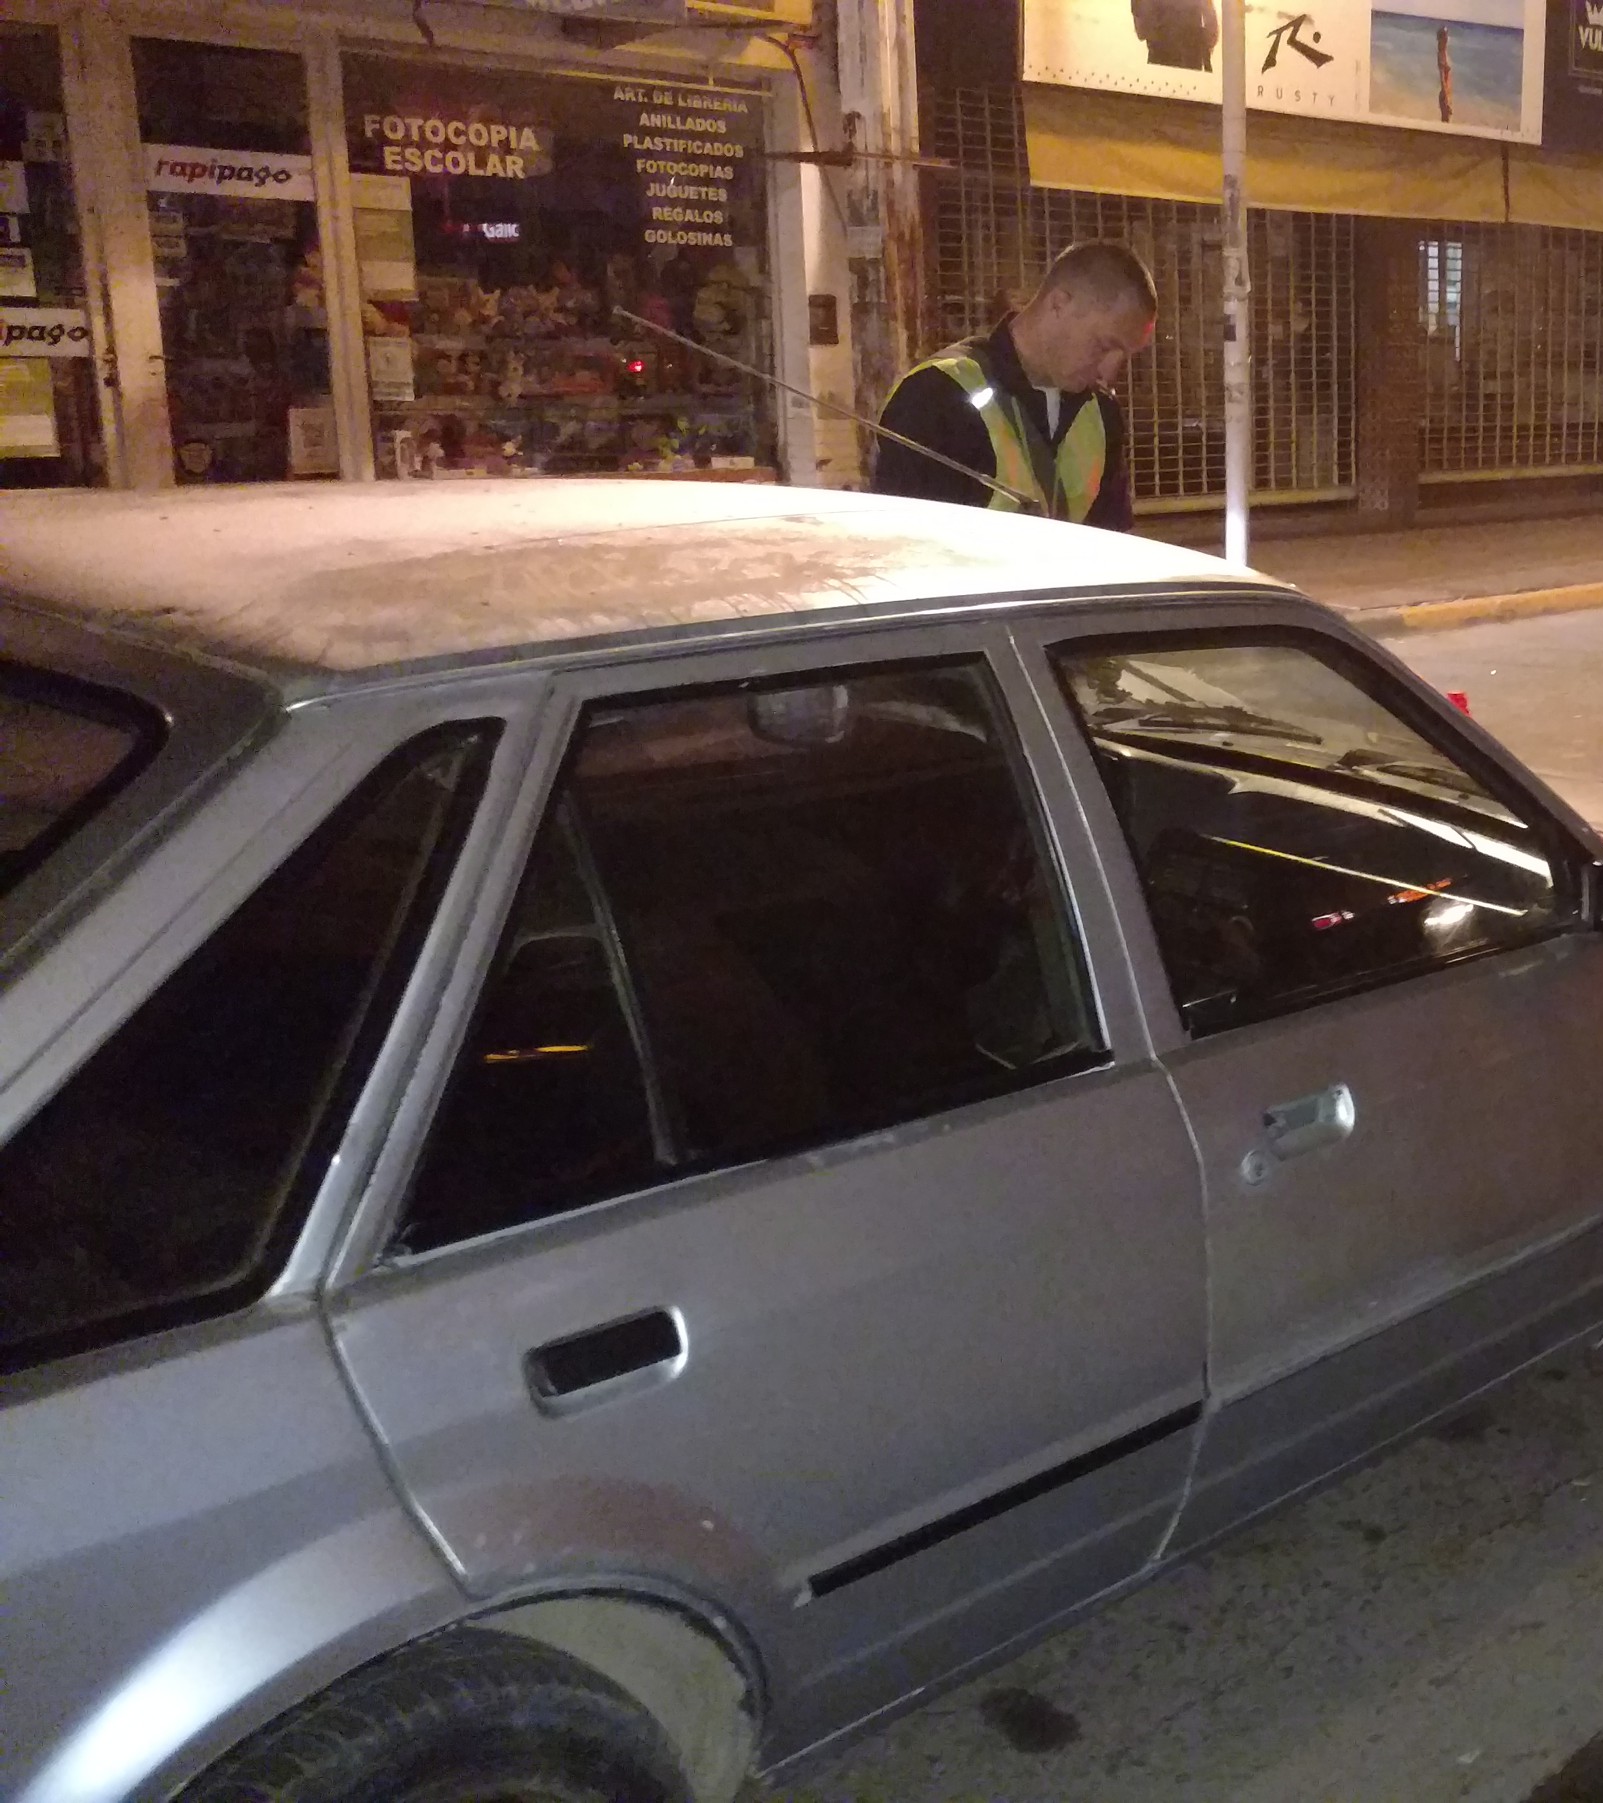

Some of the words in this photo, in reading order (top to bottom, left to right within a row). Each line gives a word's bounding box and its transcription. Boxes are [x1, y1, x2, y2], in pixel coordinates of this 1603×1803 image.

[652, 90, 673, 105] DE
[1256, 84, 1335, 107] RUSTY
[363, 114, 540, 152] FOTOCOPIA
[638, 112, 727, 134] ANILLADOS
[622, 132, 744, 159] PLASTIFICADOS
[155, 157, 293, 188] rapipago
[382, 145, 526, 179] ESCOLAR
[635, 158, 735, 181] FOTOCOPIAS
[645, 182, 729, 202] JUGUETES
[652, 206, 724, 224] REGALOS
[643, 228, 734, 248] GOLOSINAS
